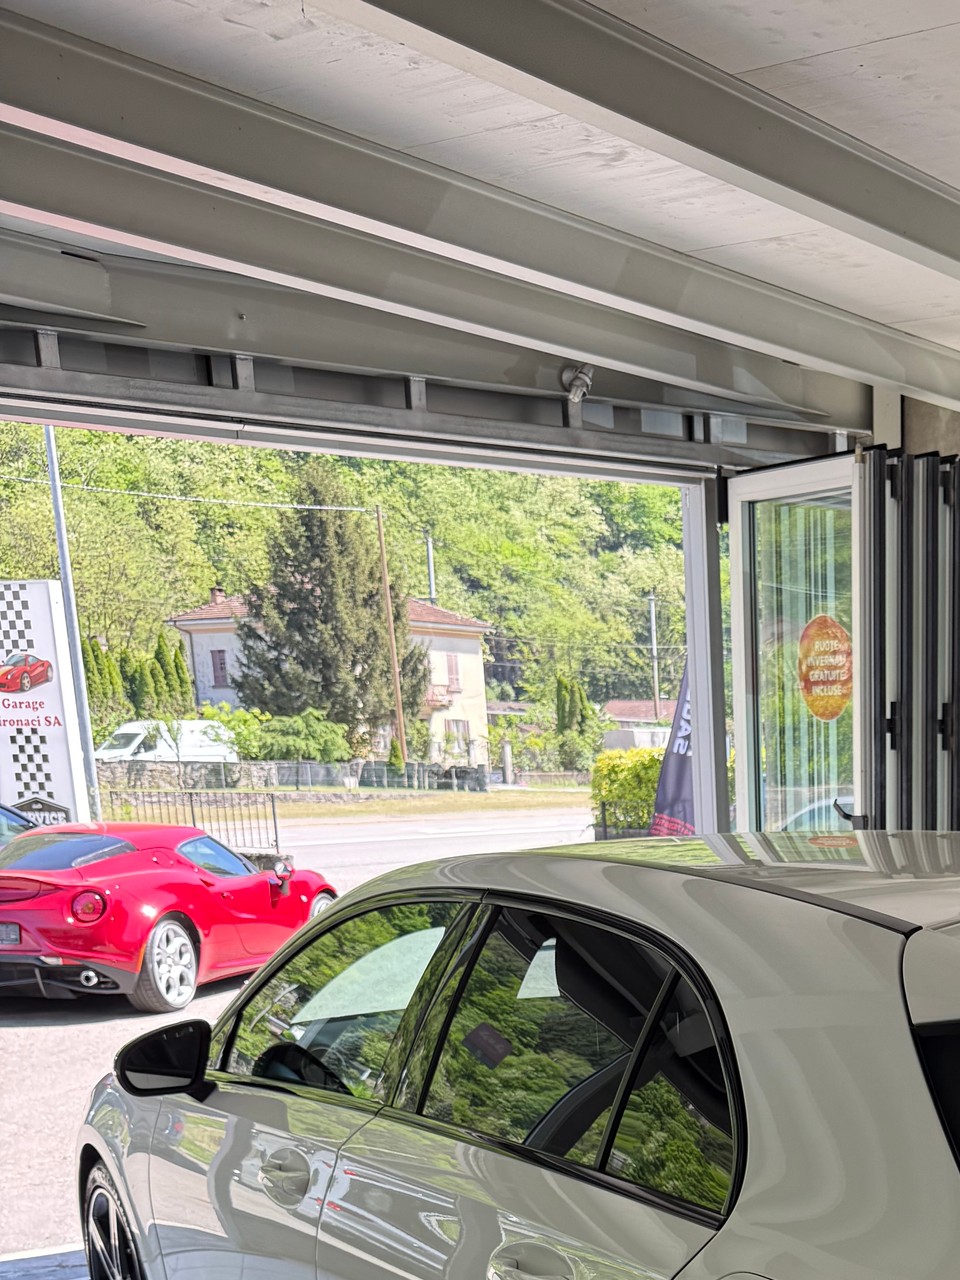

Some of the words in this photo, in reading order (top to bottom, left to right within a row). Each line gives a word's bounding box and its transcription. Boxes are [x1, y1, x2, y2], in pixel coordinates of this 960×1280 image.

[812, 685, 842, 696] INCLUSE
[2, 698, 45, 712] Garage
[44, 716, 62, 727] SA
